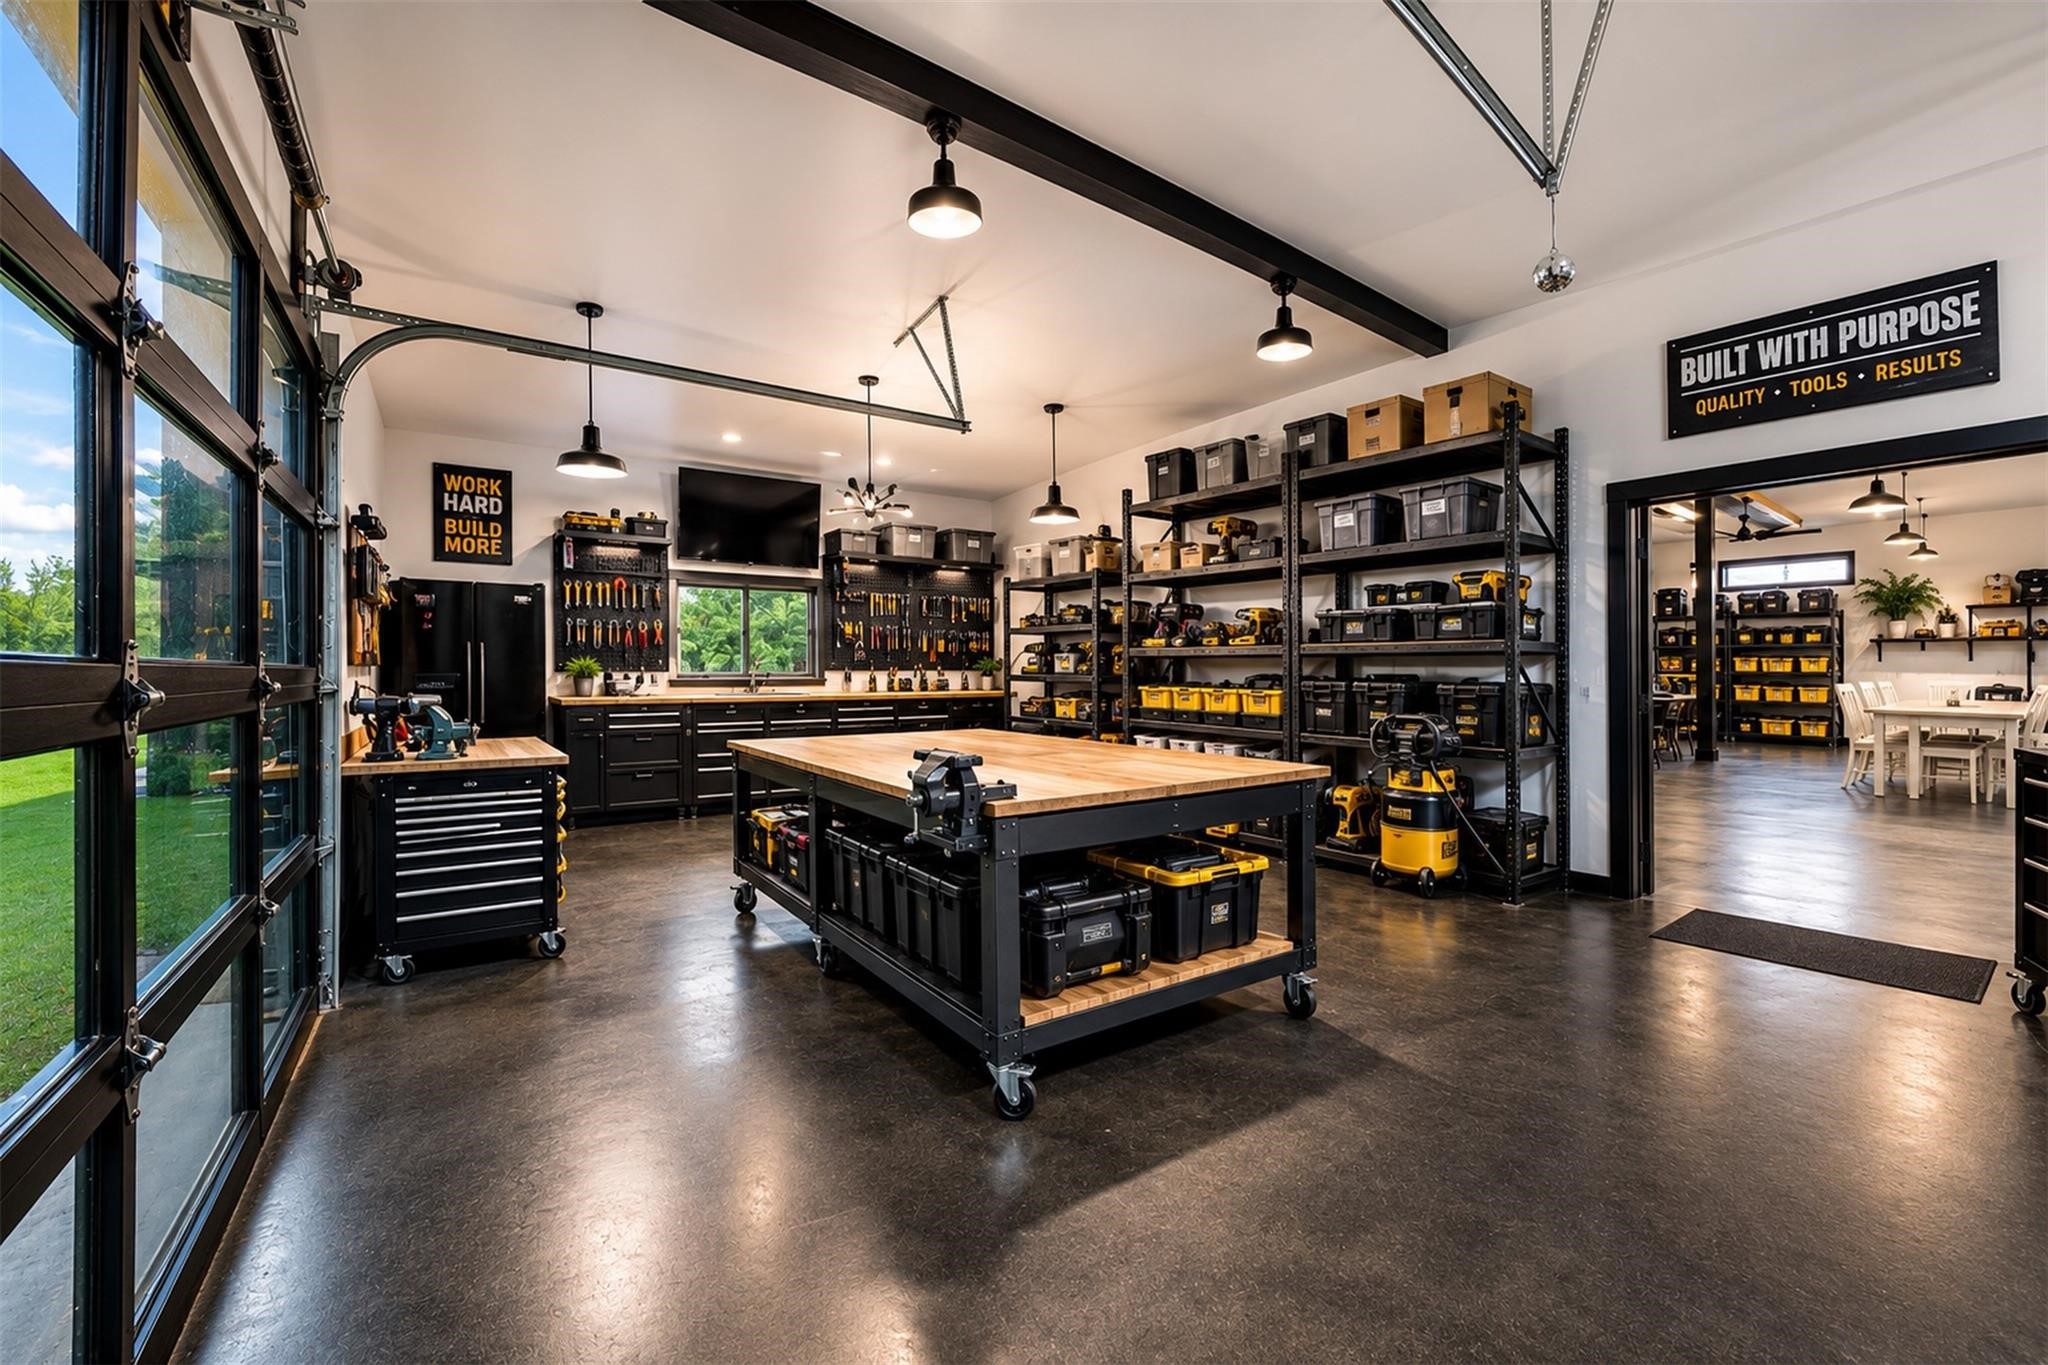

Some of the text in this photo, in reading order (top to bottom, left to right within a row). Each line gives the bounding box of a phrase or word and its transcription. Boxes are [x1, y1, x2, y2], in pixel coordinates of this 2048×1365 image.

[1680, 290, 1981, 388] BUILT WITH PURPOSE
[1695, 349, 1962, 416] QUALITY TOOLS RESULTS
[443, 473, 502, 496] WORK
[443, 493, 503, 515] HARD
[445, 518, 502, 538] BUILD
[445, 536, 502, 555] MORE
